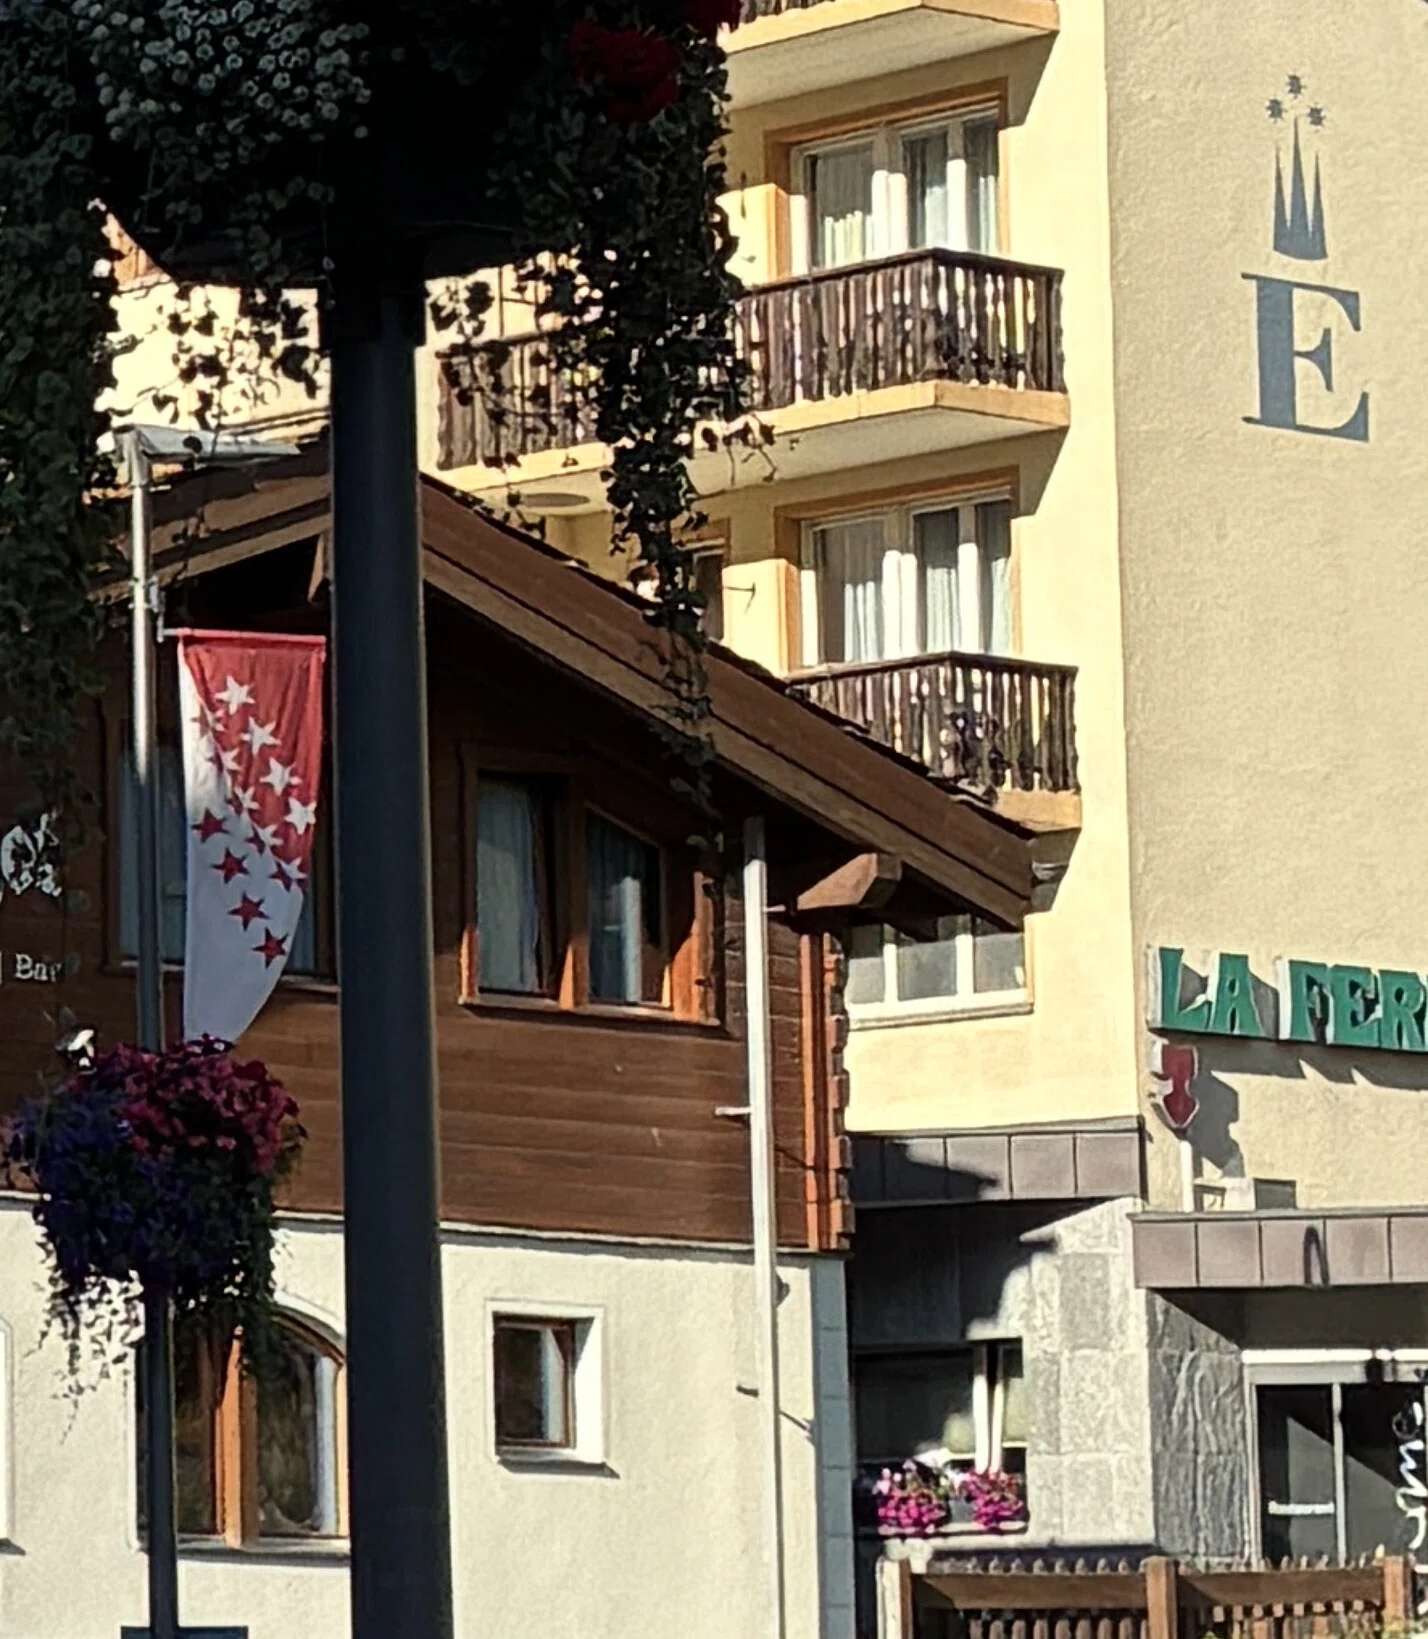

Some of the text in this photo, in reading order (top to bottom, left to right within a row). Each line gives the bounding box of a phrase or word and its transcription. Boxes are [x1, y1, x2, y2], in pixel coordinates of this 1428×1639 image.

[1241, 272, 1369, 442] E
[14, 952, 62, 984] Bar
[1153, 946, 1428, 1052] LA FER
